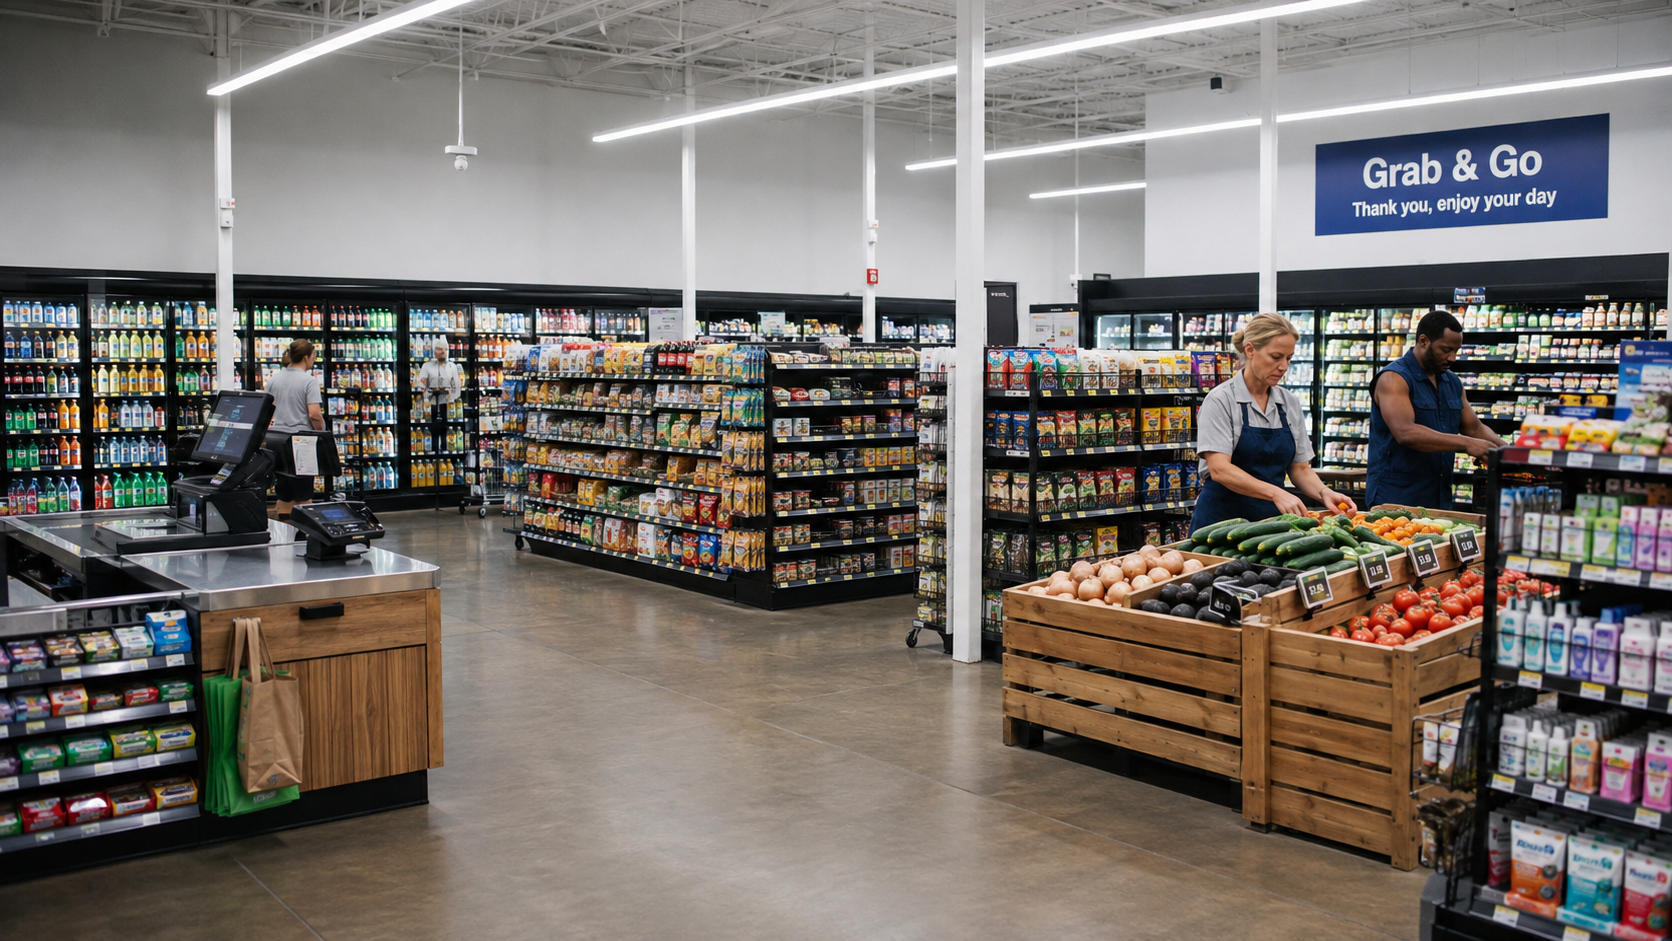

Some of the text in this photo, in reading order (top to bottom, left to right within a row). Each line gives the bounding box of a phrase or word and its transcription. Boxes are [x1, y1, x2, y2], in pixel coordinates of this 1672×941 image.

[1363, 144, 1542, 189] Grab & Go
[1352, 187, 1557, 218] Thank you, enjoy your day
